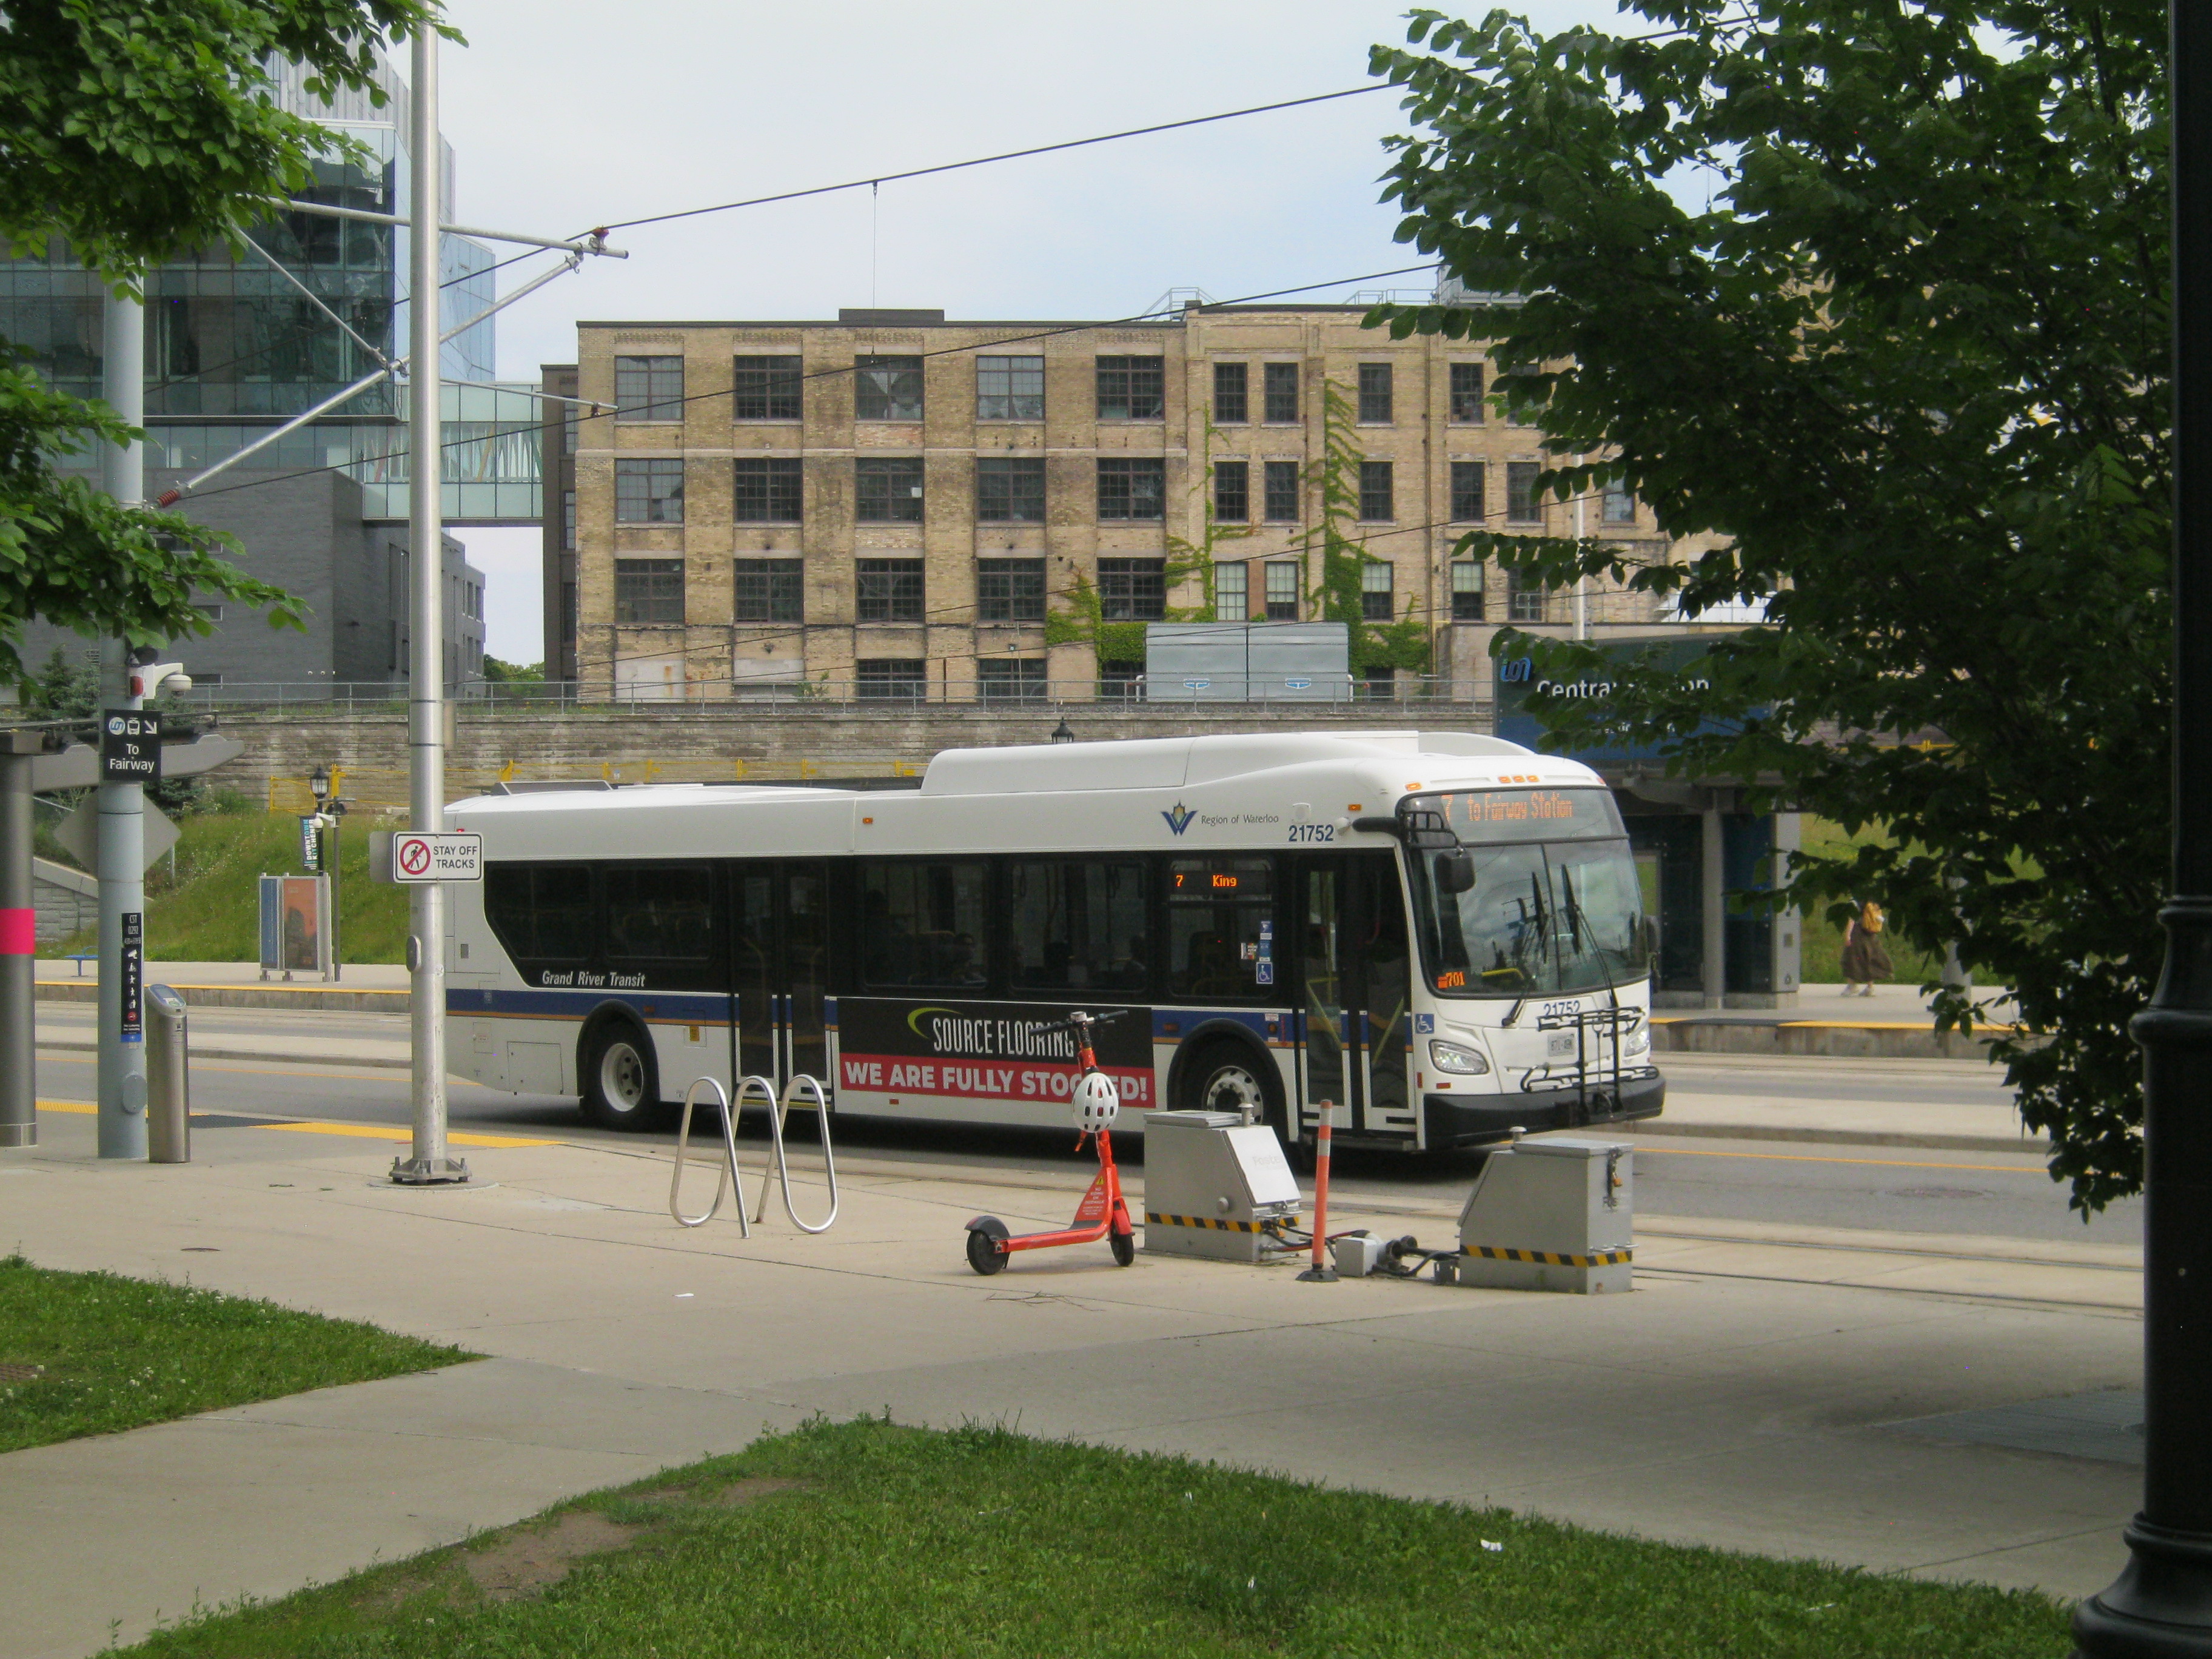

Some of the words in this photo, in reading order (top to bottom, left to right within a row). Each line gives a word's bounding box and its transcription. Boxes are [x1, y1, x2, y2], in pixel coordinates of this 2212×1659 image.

[1537, 680, 1617, 699] Centra
[126, 743, 139, 755] To
[110, 757, 155, 774] Fairway
[1484, 793, 1527, 820] Fairway
[1531, 791, 1573, 819] Station
[1201, 814, 1228, 826] Region
[1231, 814, 1239, 823] of
[1243, 813, 1279, 824] Waterloo
[303, 819, 312, 860] DOWNTOWN
[1288, 824, 1334, 842] 21752
[433, 846, 457, 856] STAY
[459, 846, 477, 856] OFF
[436, 859, 474, 869] TRACKS
[1175, 874, 1184, 888] 7
[1213, 874, 1238, 888] King
[542, 970, 573, 985] Grand
[578, 971, 605, 986] River
[609, 971, 646, 987] Transit
[1543, 1000, 1580, 1017] 21752
[933, 1017, 993, 1054] SOURCE
[997, 1020, 1074, 1057] FLOORING
[845, 1061, 883, 1085] WE
[889, 1064, 935, 1088] ARE
[942, 1067, 1014, 1093] FULLY
[1021, 1070, 1147, 1101] STOCD!
